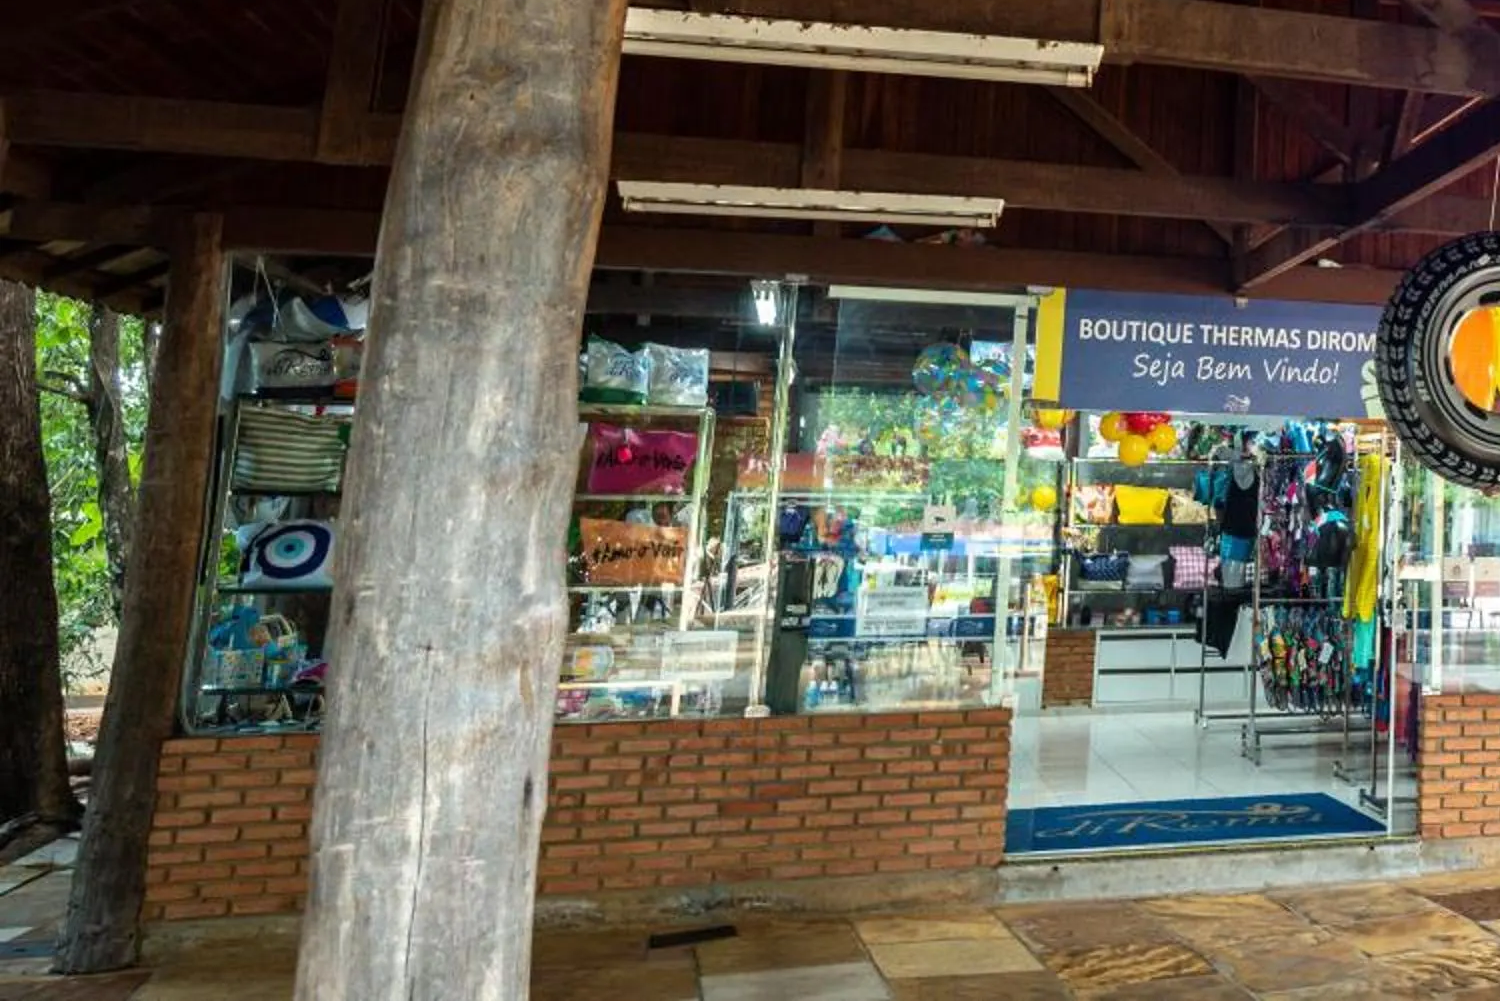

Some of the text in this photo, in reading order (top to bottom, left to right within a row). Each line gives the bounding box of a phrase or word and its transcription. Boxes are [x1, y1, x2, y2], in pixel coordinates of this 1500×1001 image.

[1079, 318, 1377, 352] BOUTIQUE THERMAS DIROM
[1132, 351, 1340, 387] Seja Bem Vindo!
